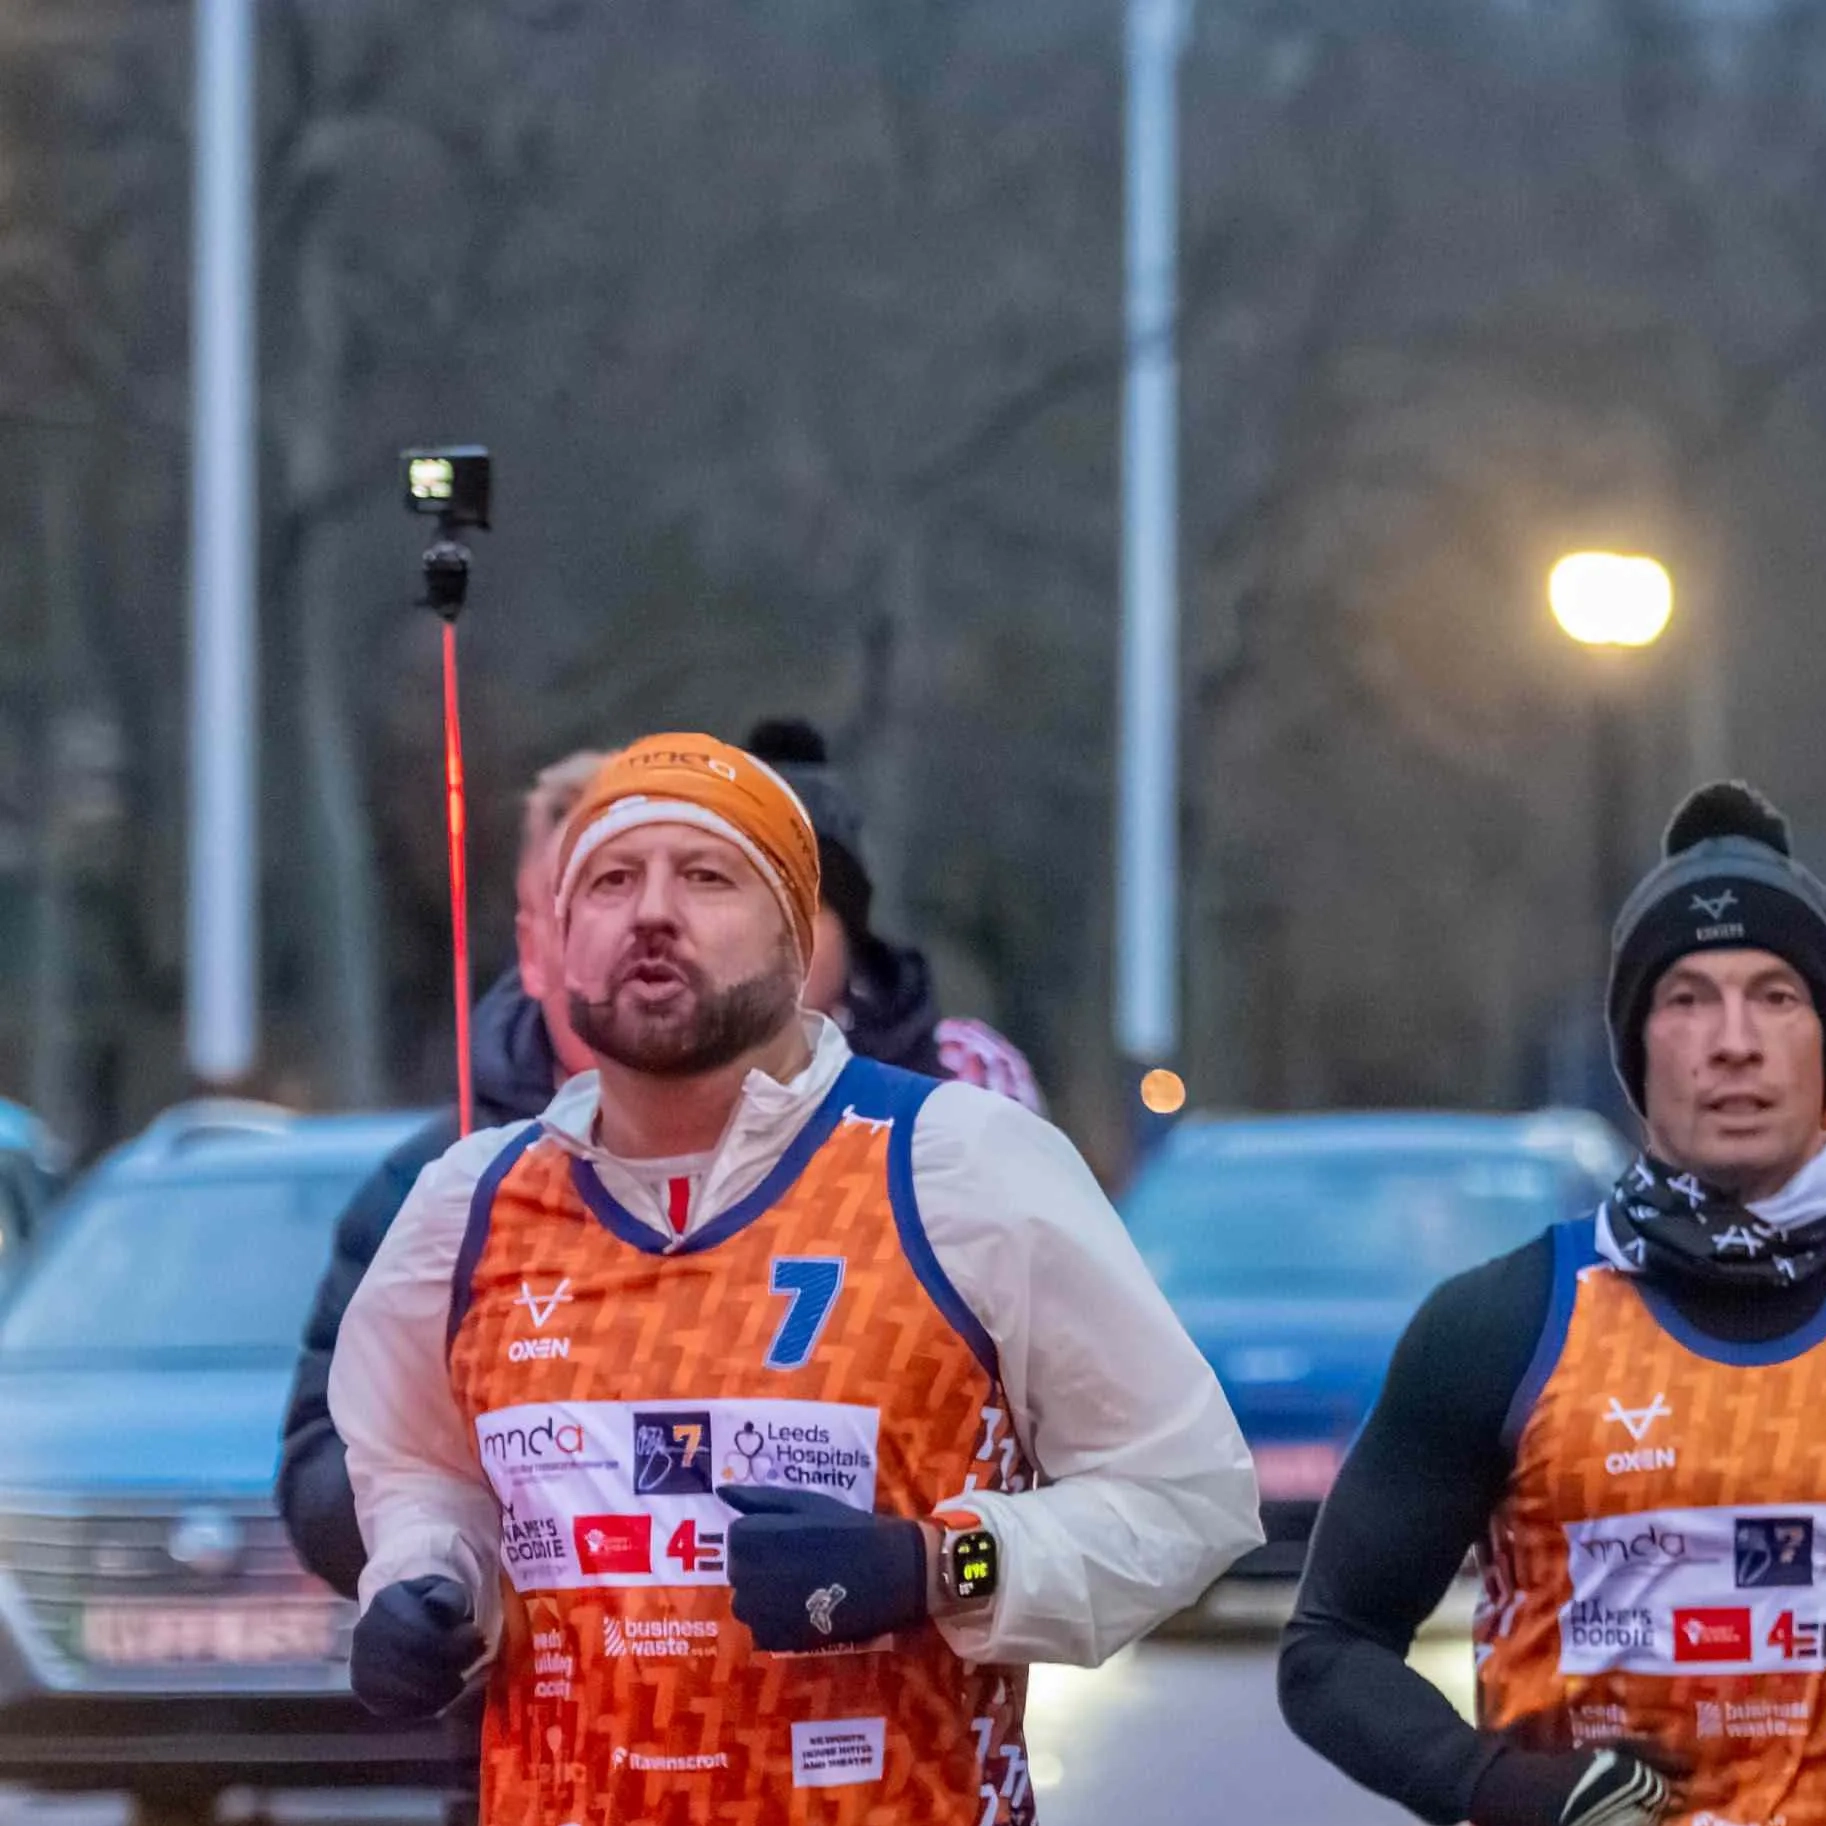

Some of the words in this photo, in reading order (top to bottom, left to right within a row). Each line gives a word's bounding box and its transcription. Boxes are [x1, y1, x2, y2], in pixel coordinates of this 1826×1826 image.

[762, 1256, 847, 1371] 7
[508, 1337, 571, 1363] OXEN
[485, 1416, 584, 1460] mnda
[768, 1421, 830, 1443] Leeds
[673, 1424, 703, 1468] 7
[776, 1444, 871, 1469] Hospitals
[1605, 1448, 1676, 1475] OXEN
[784, 1465, 857, 1491] Charity
[624, 1617, 719, 1638] business
[631, 1637, 689, 1656] waste
